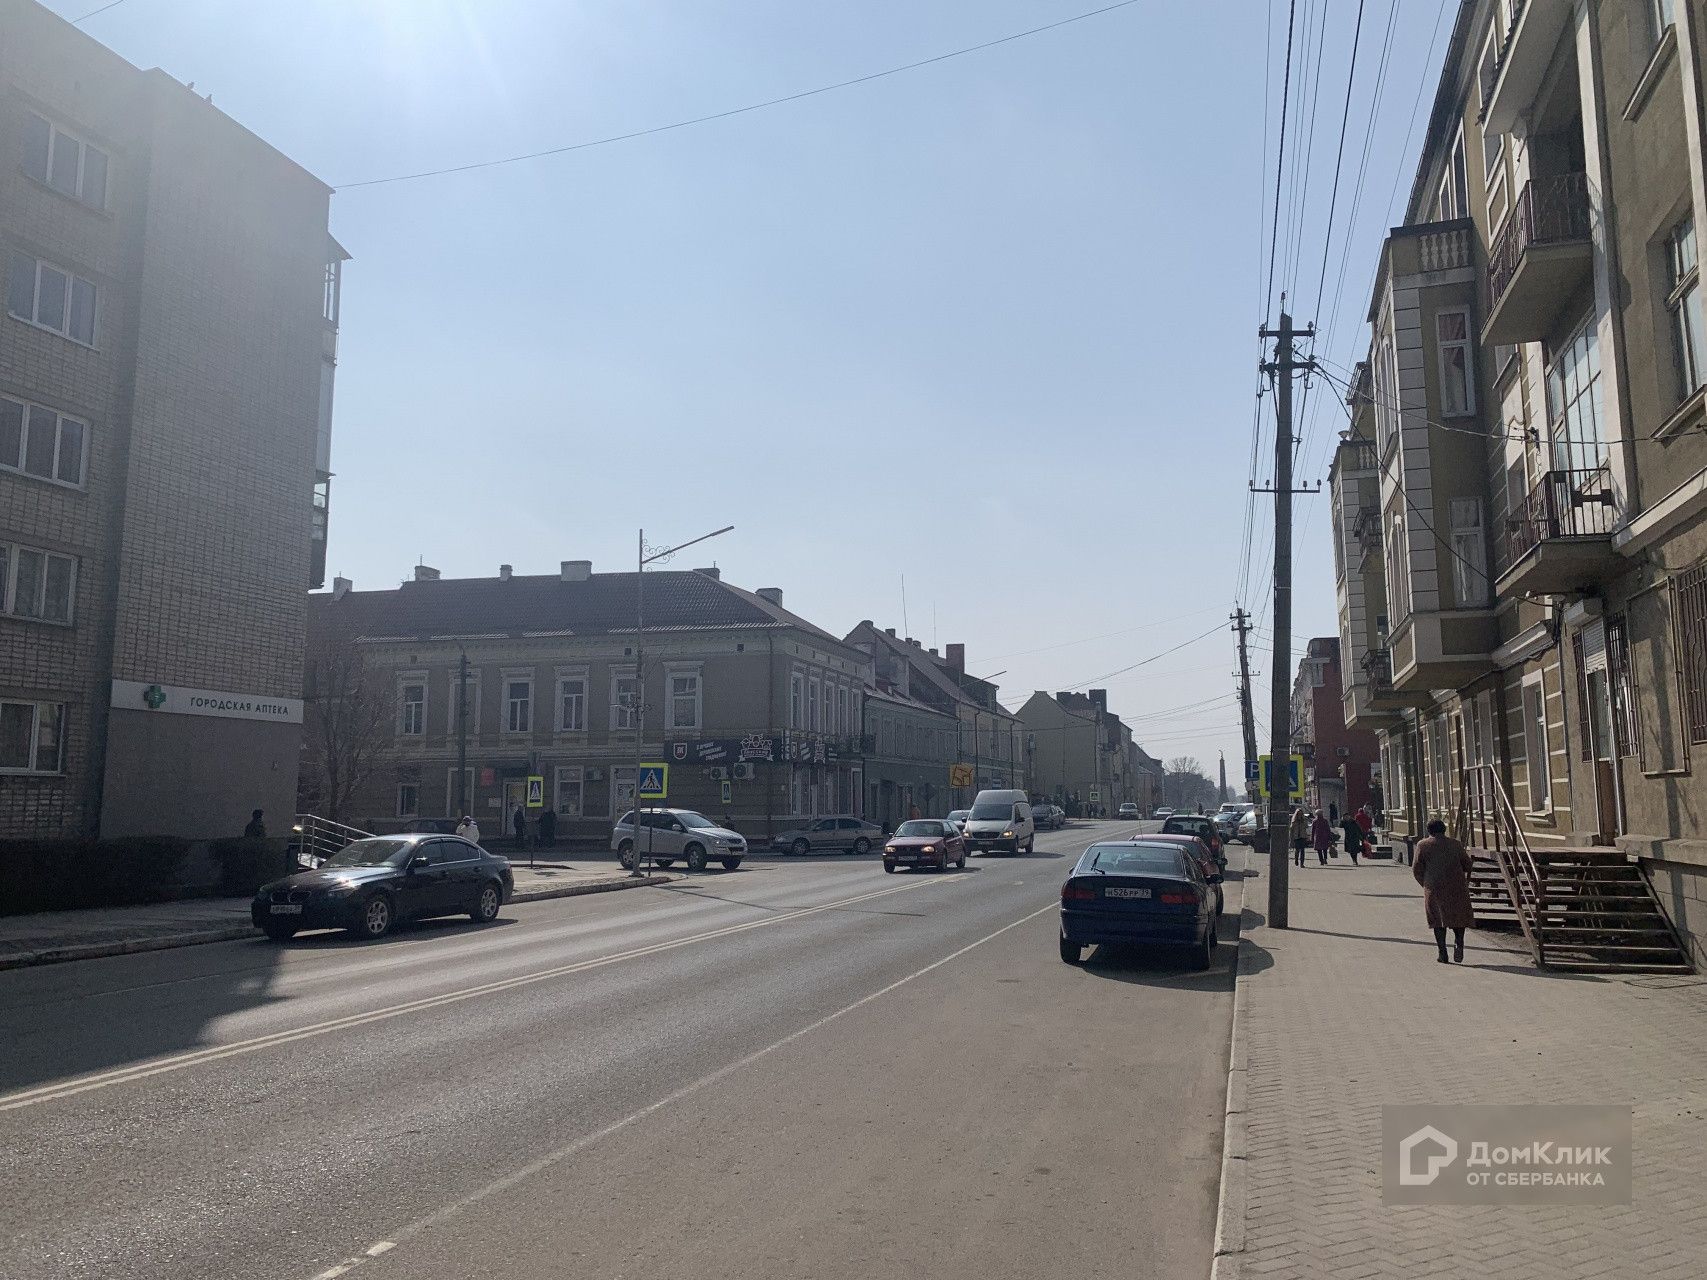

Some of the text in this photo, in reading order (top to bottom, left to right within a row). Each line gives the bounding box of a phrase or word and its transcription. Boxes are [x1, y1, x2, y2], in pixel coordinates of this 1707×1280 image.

[190, 697, 289, 715] ГОРОДСКАЯ АПТЕКА
[1250, 762, 1260, 778] P
